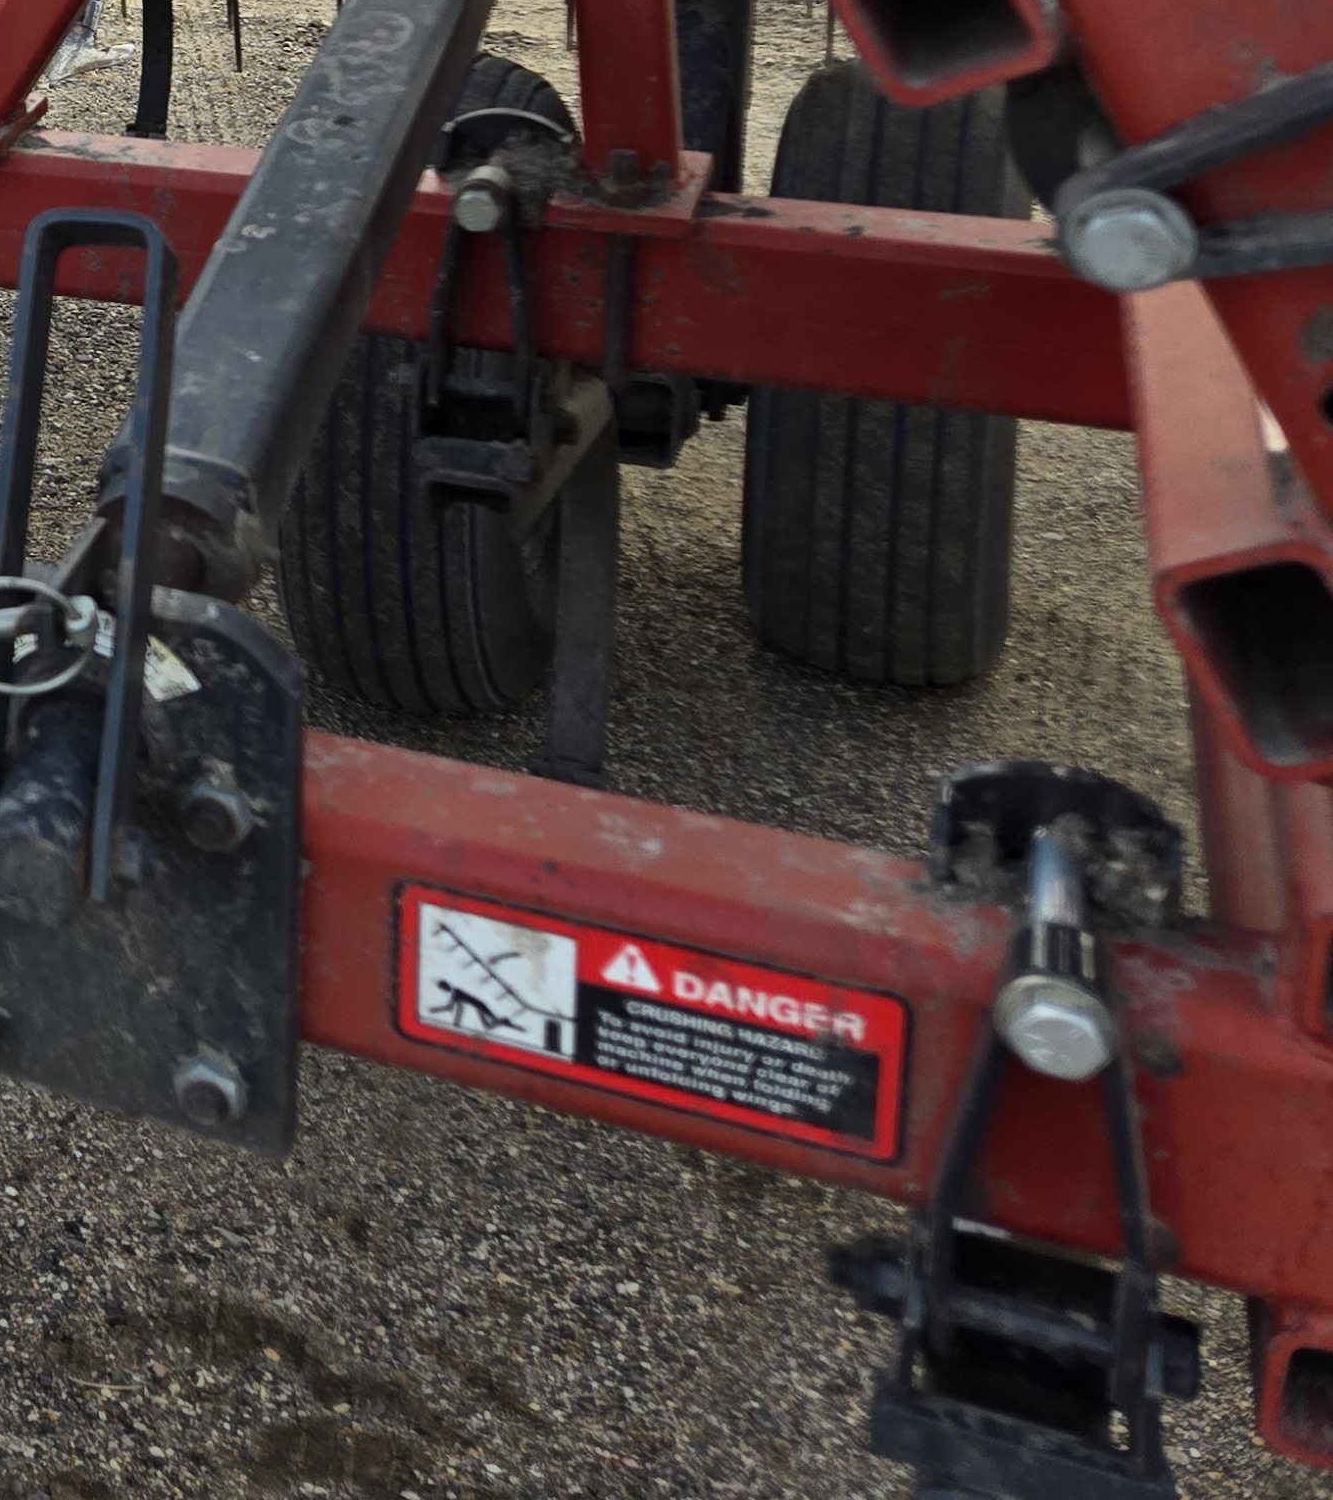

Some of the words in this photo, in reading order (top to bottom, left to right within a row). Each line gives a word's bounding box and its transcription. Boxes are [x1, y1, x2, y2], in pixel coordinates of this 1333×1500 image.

[626, 1000, 733, 1038] CRUSHING
[738, 1027, 824, 1060] HAZARD
[674, 970, 865, 1043] DANGER
[597, 1026, 646, 1050] keep
[653, 1042, 749, 1073] everyone
[756, 1067, 812, 1088] clear
[598, 1009, 623, 1028] To
[629, 1021, 686, 1043] avoid
[694, 1036, 754, 1063] injury
[761, 1055, 785, 1068] or
[596, 1055, 620, 1069] or
[625, 1062, 727, 1099] unfolding
[597, 1041, 684, 1071] machine
[692, 1065, 747, 1086] when
[754, 1078, 832, 1114] folding
